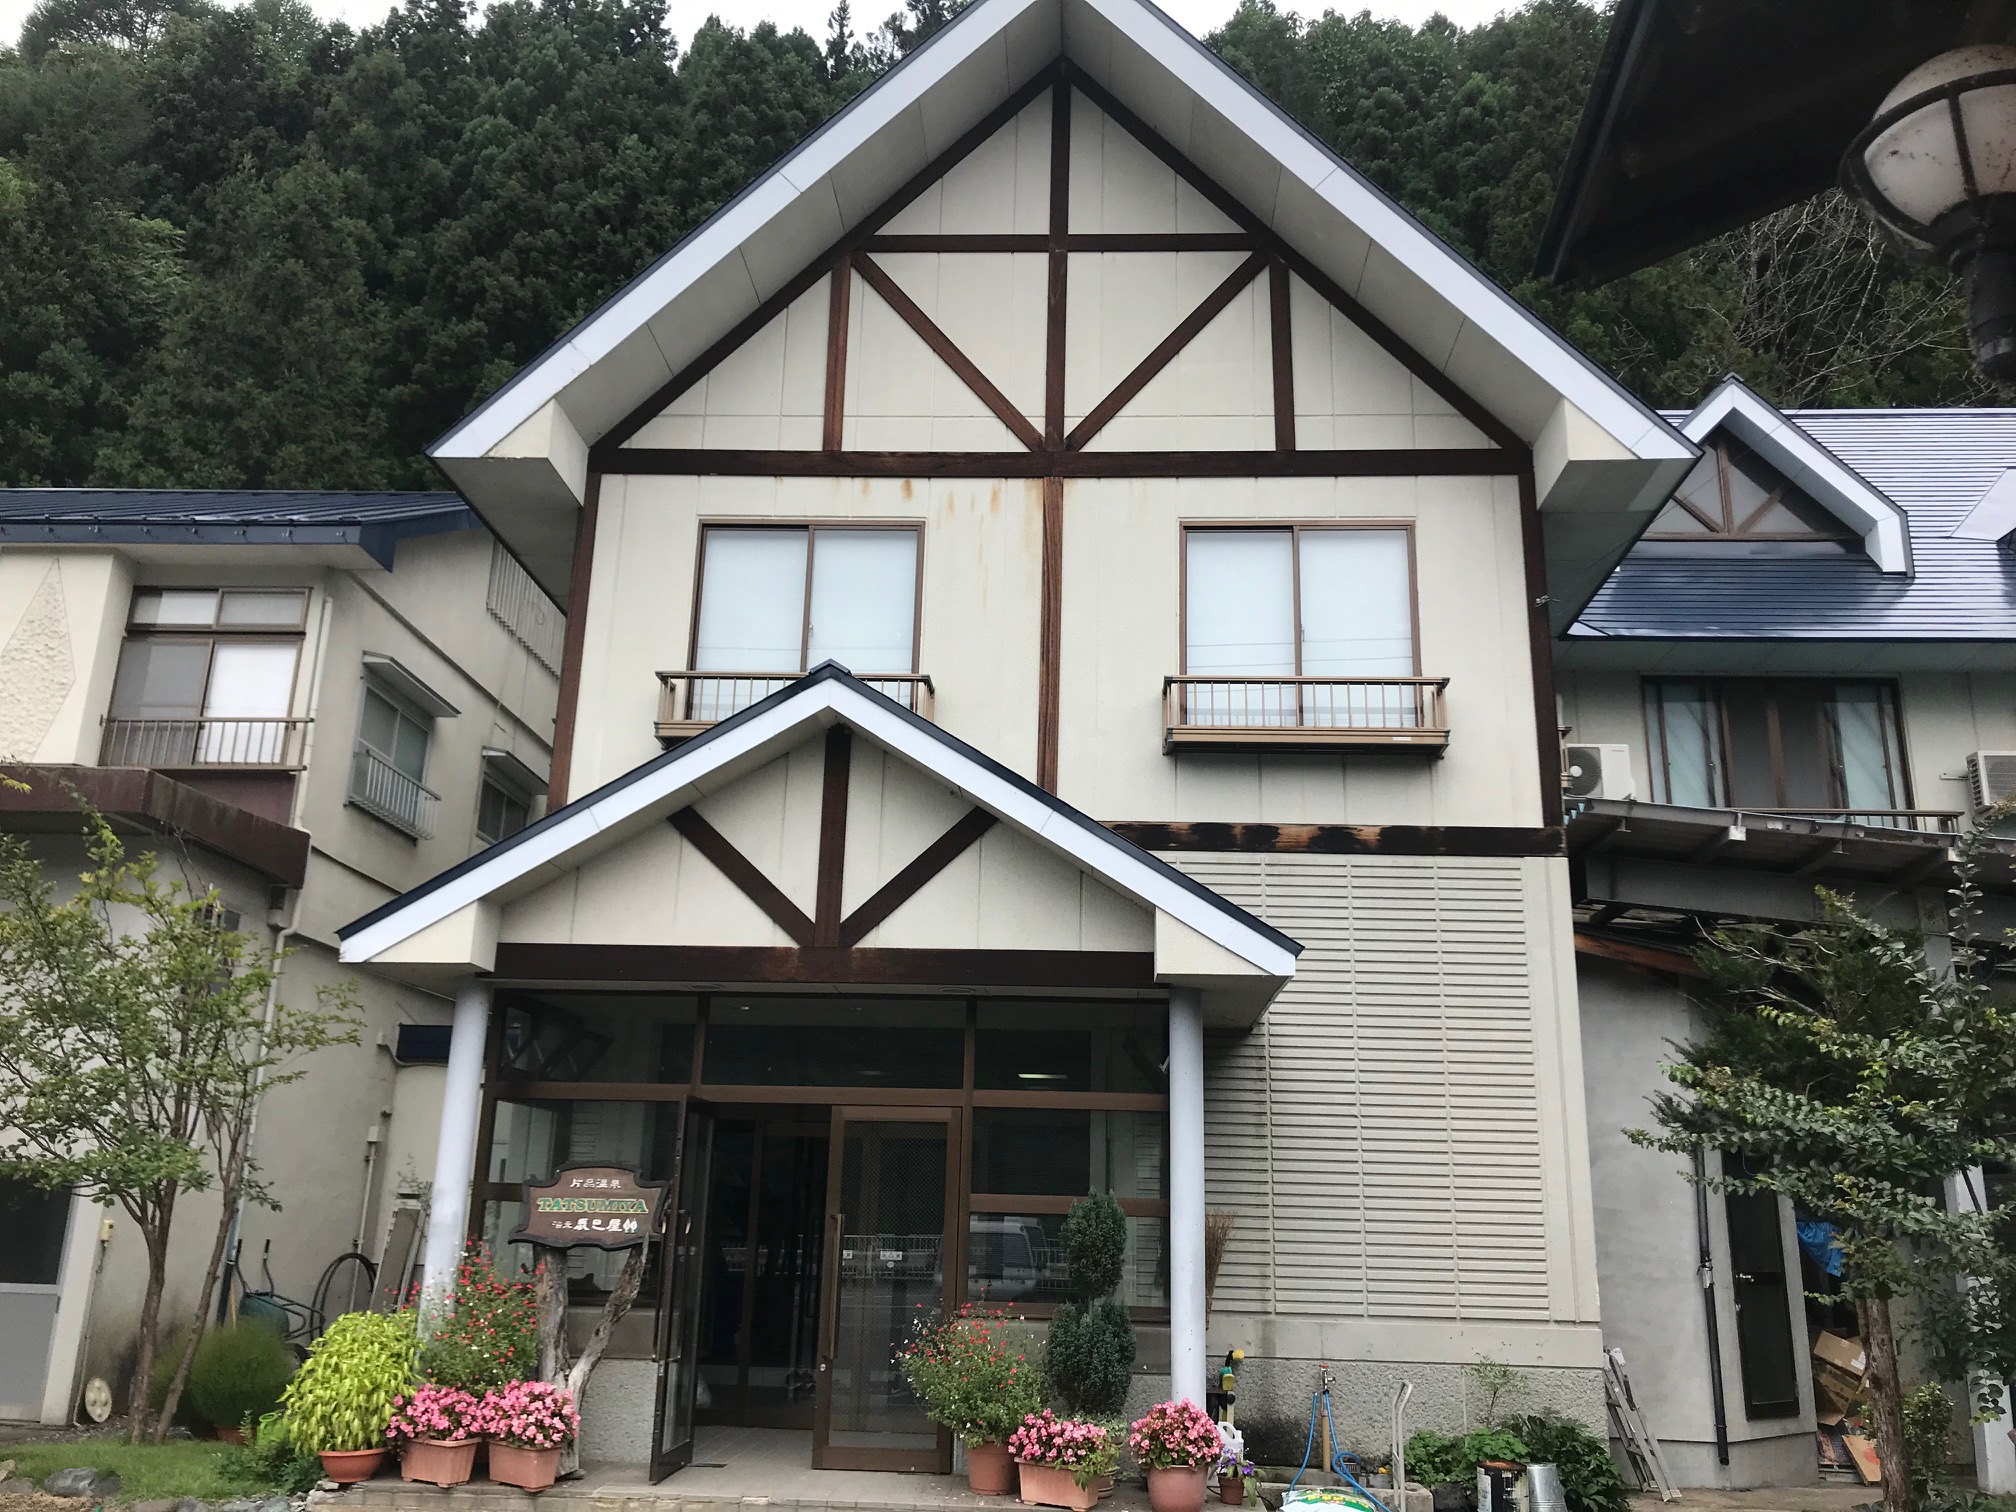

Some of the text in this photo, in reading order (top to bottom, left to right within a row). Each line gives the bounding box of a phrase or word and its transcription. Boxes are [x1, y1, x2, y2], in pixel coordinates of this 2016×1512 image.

[569, 1178, 622, 1189] 片品温泉
[537, 1198, 649, 1213] TATSUMIYA
